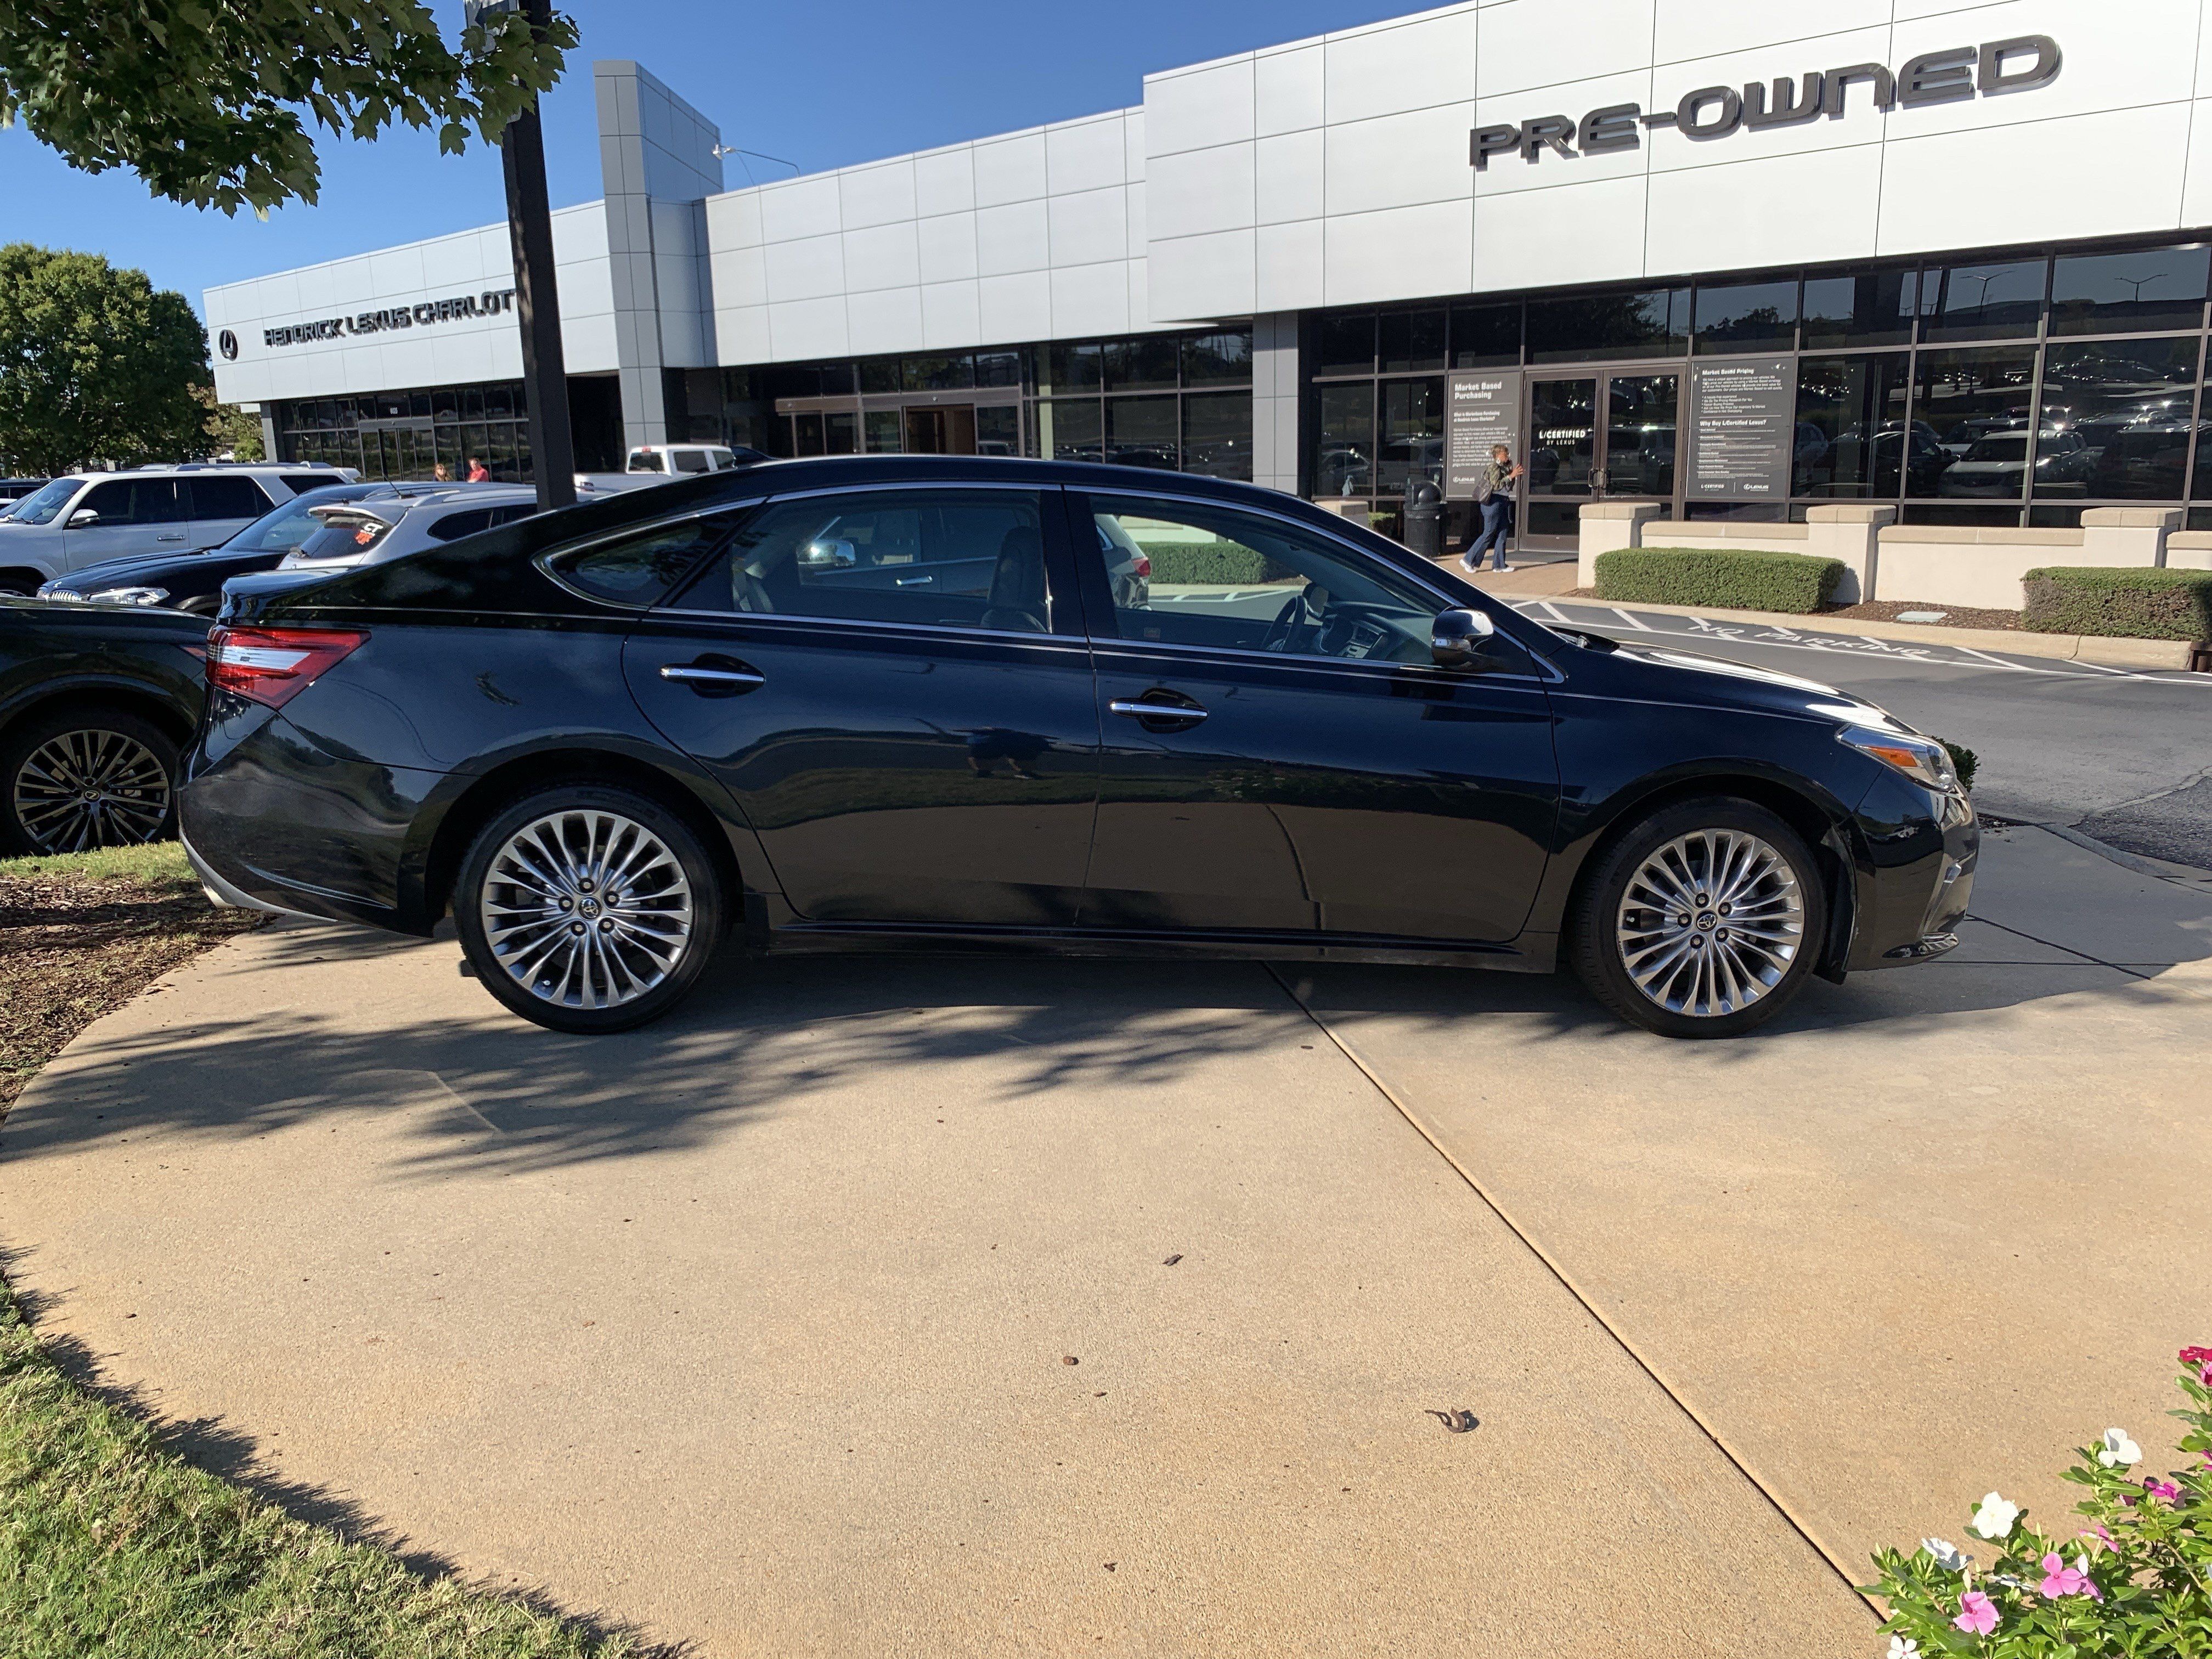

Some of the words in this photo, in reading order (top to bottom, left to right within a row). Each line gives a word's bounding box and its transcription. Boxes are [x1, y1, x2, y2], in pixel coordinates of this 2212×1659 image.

[1470, 34, 2062, 172] PRE-OWNED
[264, 318, 346, 347] HENDRICK
[345, 307, 412, 336] LEXUS
[413, 288, 517, 326] CHARLOT
[1454, 382, 1480, 391] Market
[1481, 381, 1502, 390] Based
[1454, 391, 1492, 400] Purchasing
[1539, 430, 1585, 439] L/CERTIFIED
[1688, 626, 1745, 635] NO
[1754, 632, 1931, 656] PARKING
